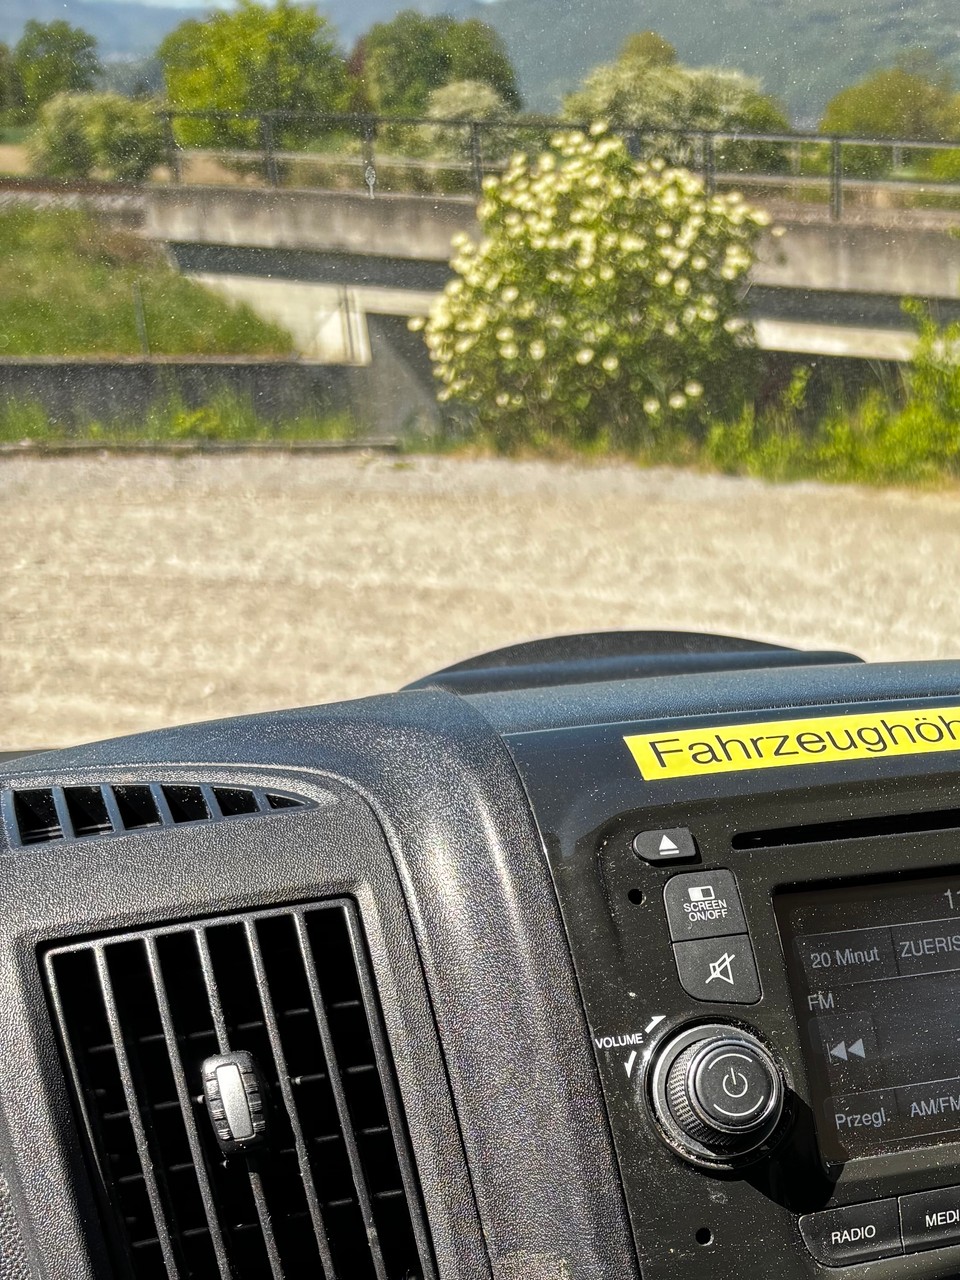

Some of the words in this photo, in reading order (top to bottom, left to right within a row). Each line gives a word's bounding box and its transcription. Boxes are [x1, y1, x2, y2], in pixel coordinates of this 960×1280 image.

[683, 900, 727, 912] SCREEN
[688, 909, 728, 922] ON/OFF
[811, 953, 831, 968] 20
[836, 947, 880, 965] Minut
[808, 994, 834, 1011] FM
[595, 1033, 644, 1049] VOLUME
[835, 1107, 890, 1130] Przegl.
[831, 1225, 876, 1245] RADIO
